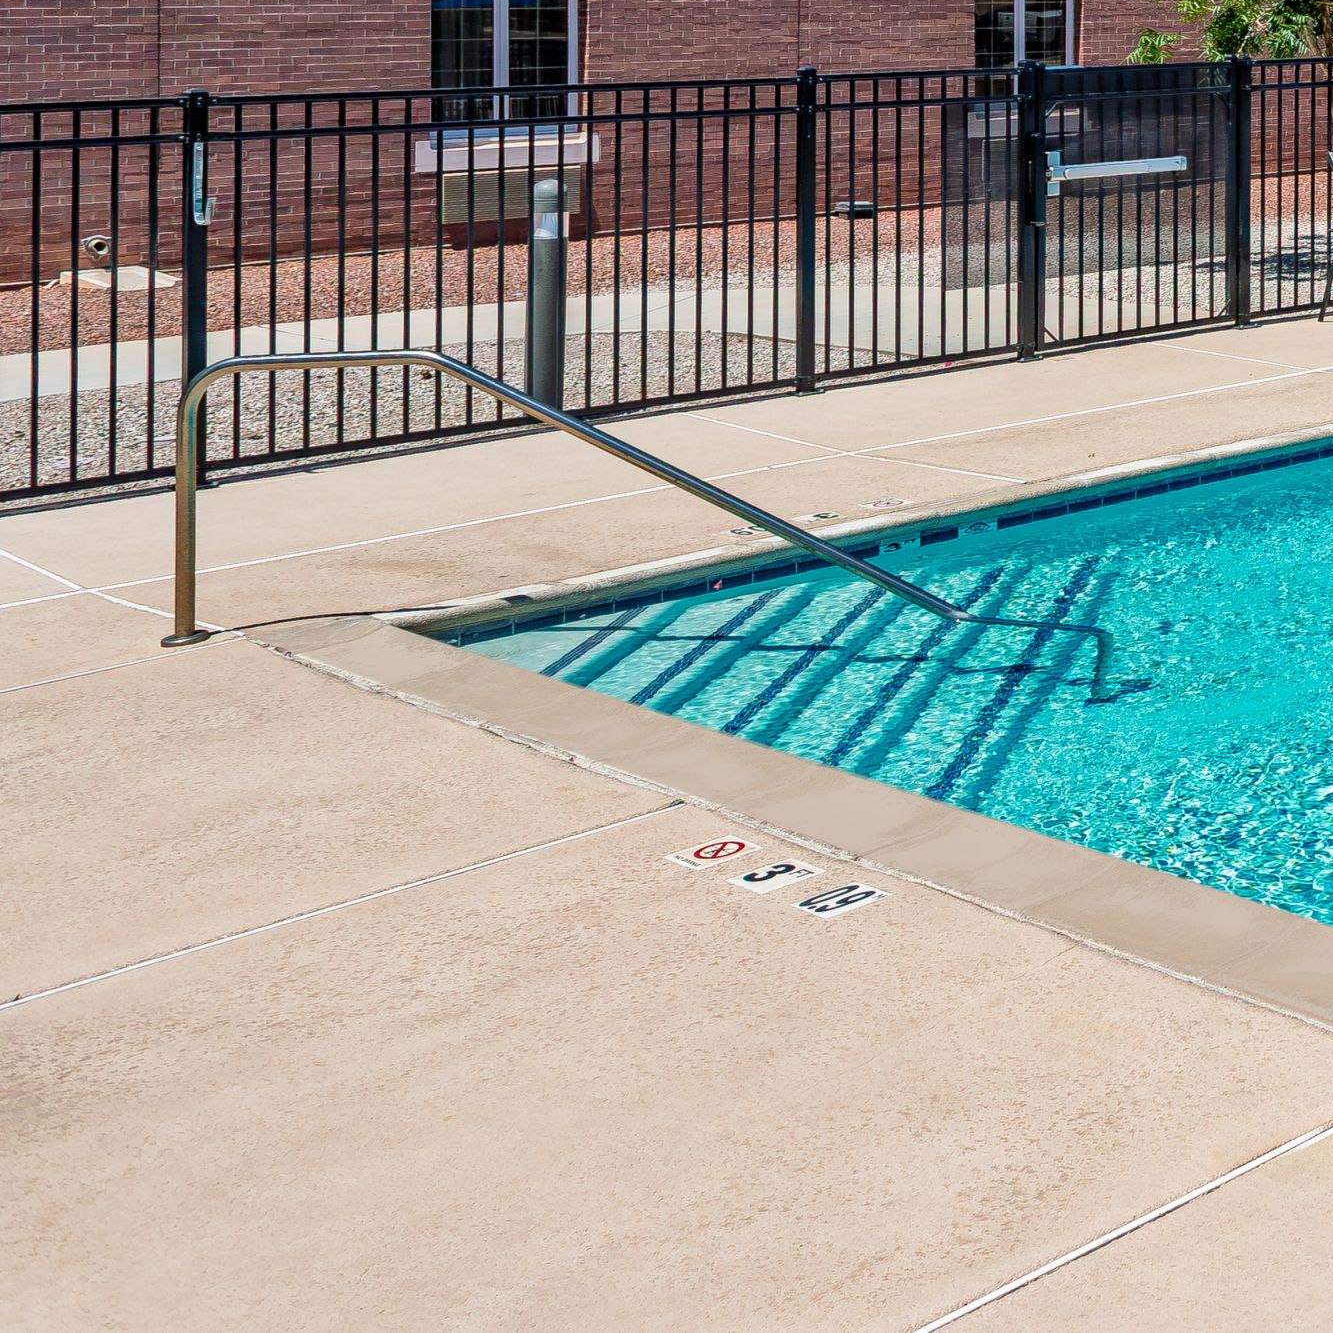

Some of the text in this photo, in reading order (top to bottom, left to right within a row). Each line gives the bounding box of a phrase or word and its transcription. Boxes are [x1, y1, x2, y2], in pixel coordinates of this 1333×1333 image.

[742, 863, 815, 882] 3 FT
[799, 884, 877, 913] 0.9
